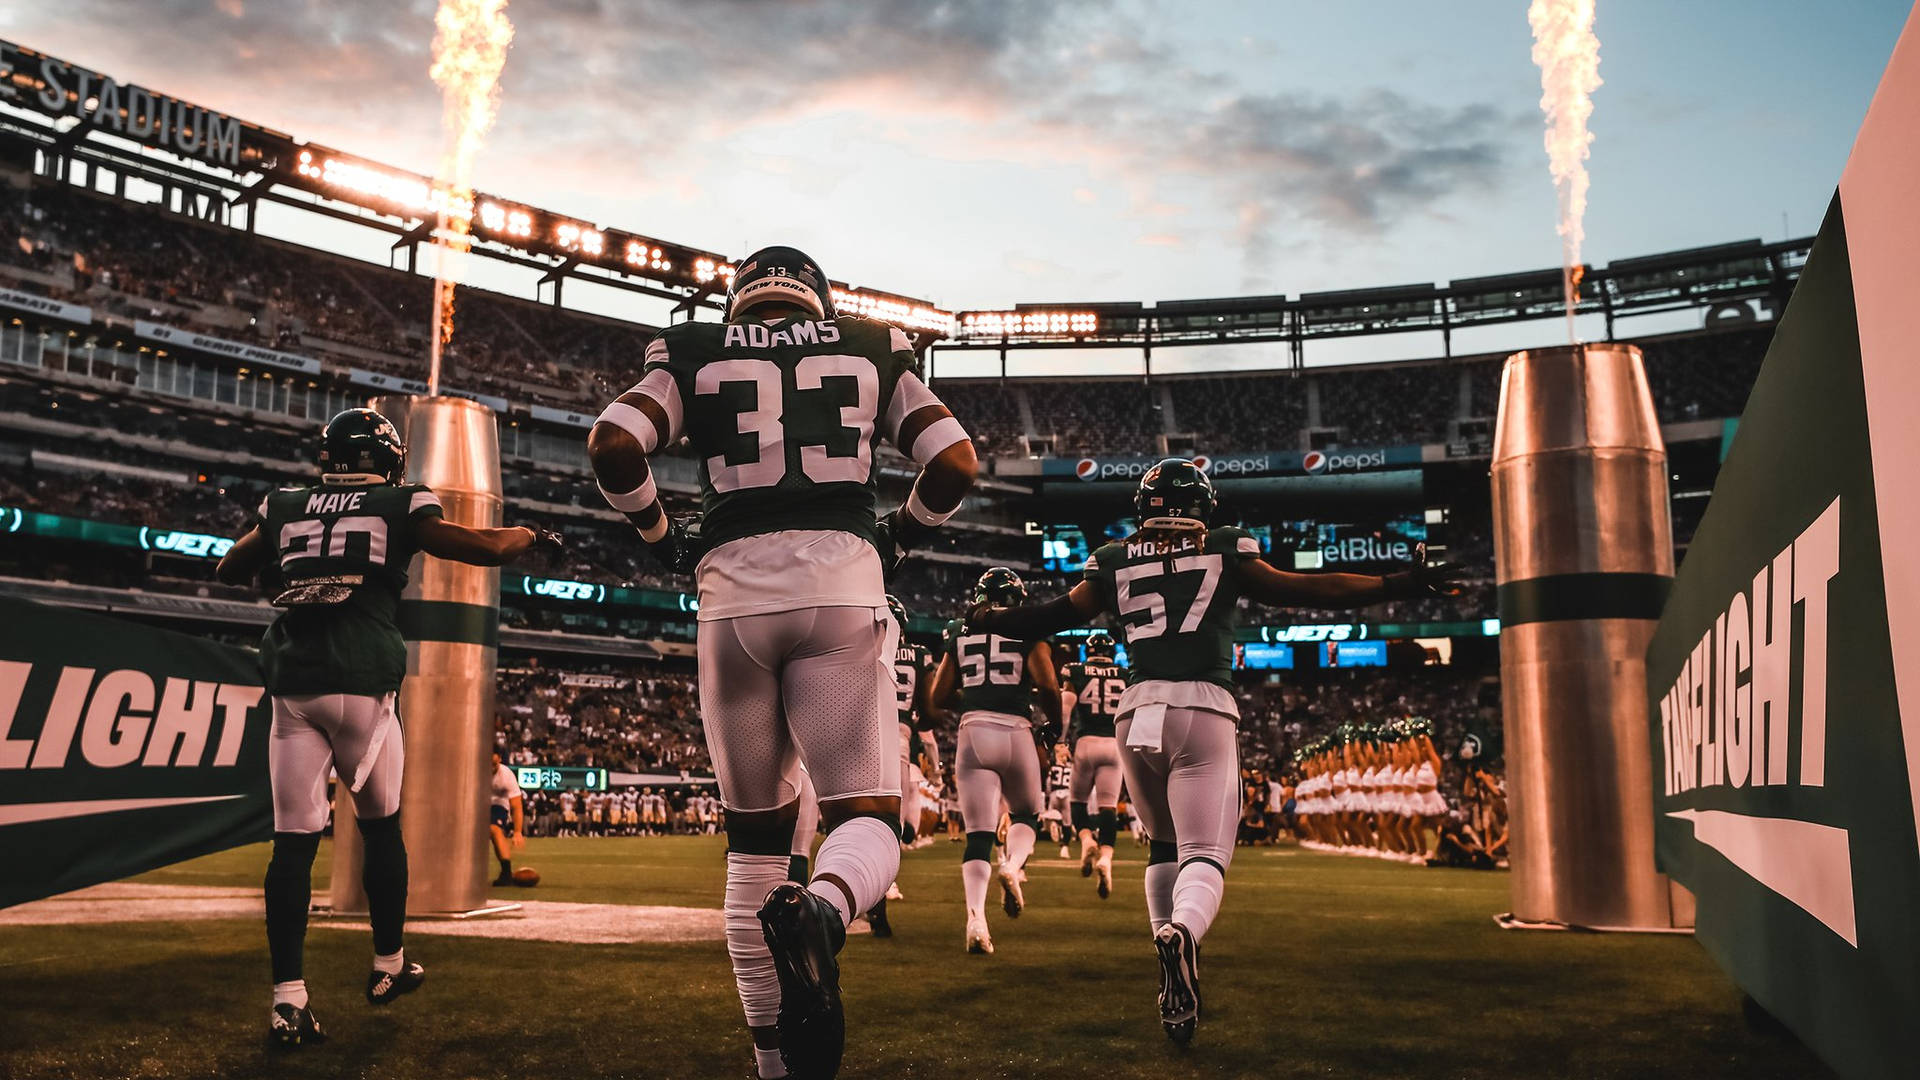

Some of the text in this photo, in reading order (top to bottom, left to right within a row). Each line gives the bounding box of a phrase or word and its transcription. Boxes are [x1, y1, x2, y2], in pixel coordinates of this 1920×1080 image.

[38, 58, 241, 166] STADIUM
[767, 267, 786, 277] 33
[744, 281, 808, 294] NEW YORK
[724, 320, 840, 349] ADAMS
[695, 355, 880, 494] 33
[1102, 460, 1155, 479] peps
[1214, 456, 1269, 475] pepsi
[1328, 450, 1385, 471] pepsi
[305, 492, 367, 514] MAYE
[1169, 508, 1182, 517] 57
[155, 531, 237, 557] JETS
[1315, 537, 1409, 568] jetBlue
[535, 580, 594, 599] JETS
[1115, 554, 1223, 644] 57
[1276, 624, 1352, 642] JETS
[957, 634, 1023, 688] 55
[1084, 665, 1120, 677] HEWITT
[0, 660, 265, 769] LIGHT
